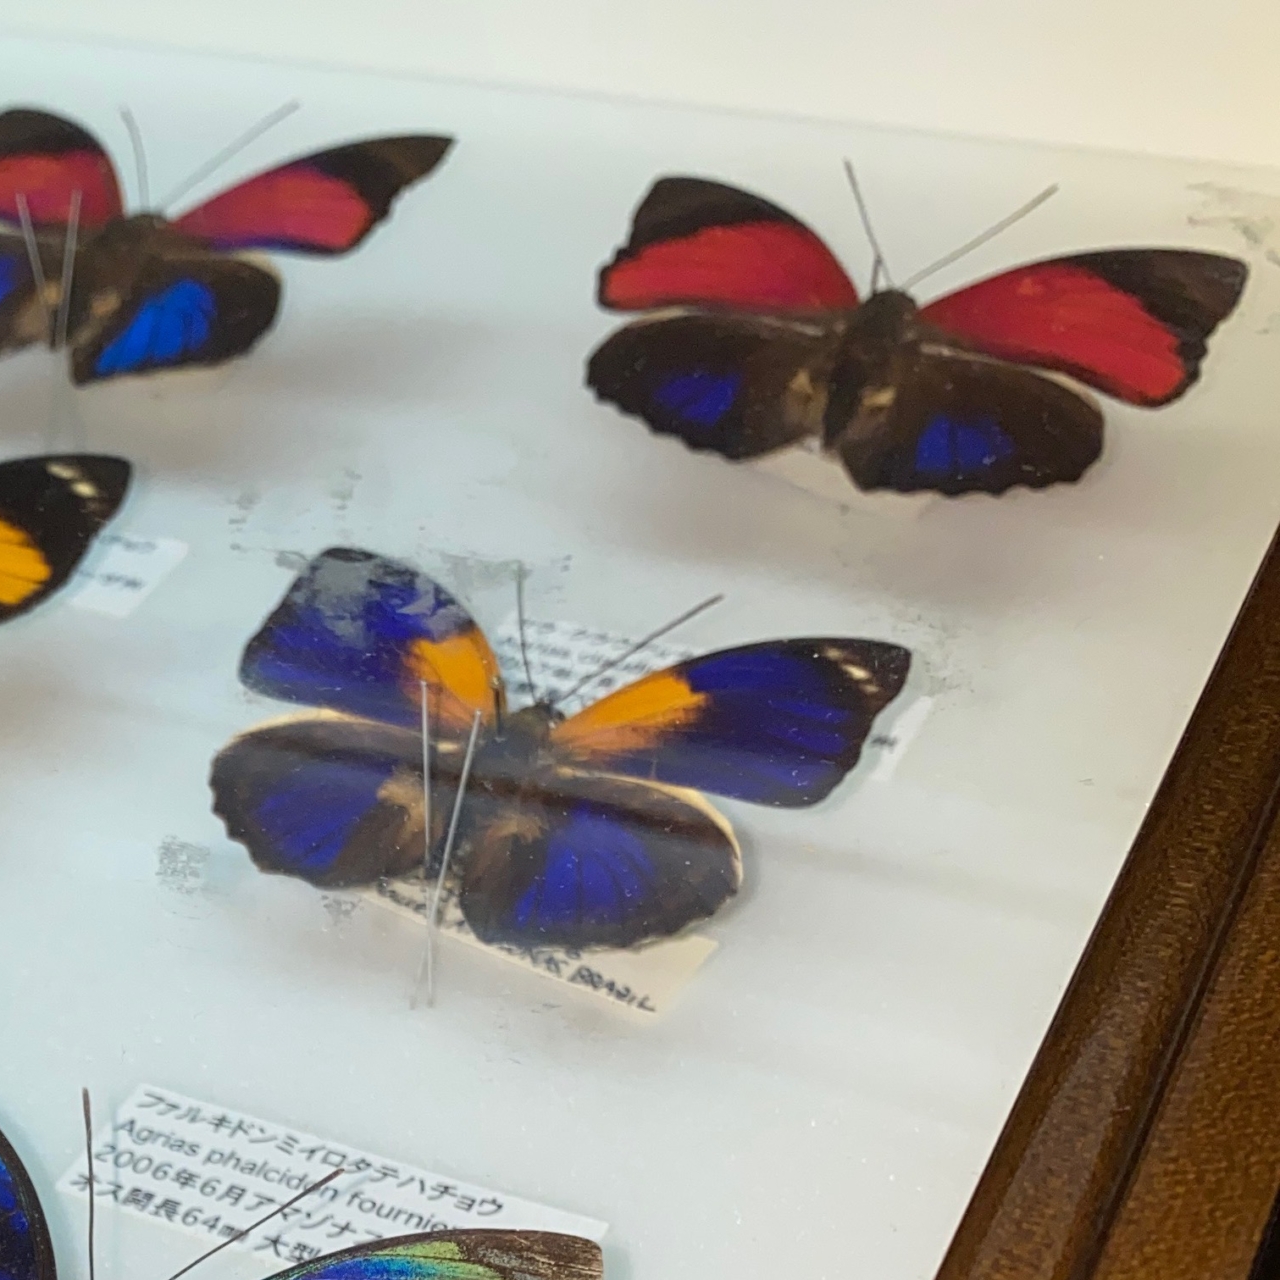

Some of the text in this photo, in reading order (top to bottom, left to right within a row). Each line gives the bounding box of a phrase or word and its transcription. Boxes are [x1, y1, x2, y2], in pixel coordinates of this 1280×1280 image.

[112, 1118, 201, 1157] Agrias
[202, 1148, 338, 1202] phalcidon
[137, 1090, 504, 1216] ファルキドンミイロタテハチョウ
